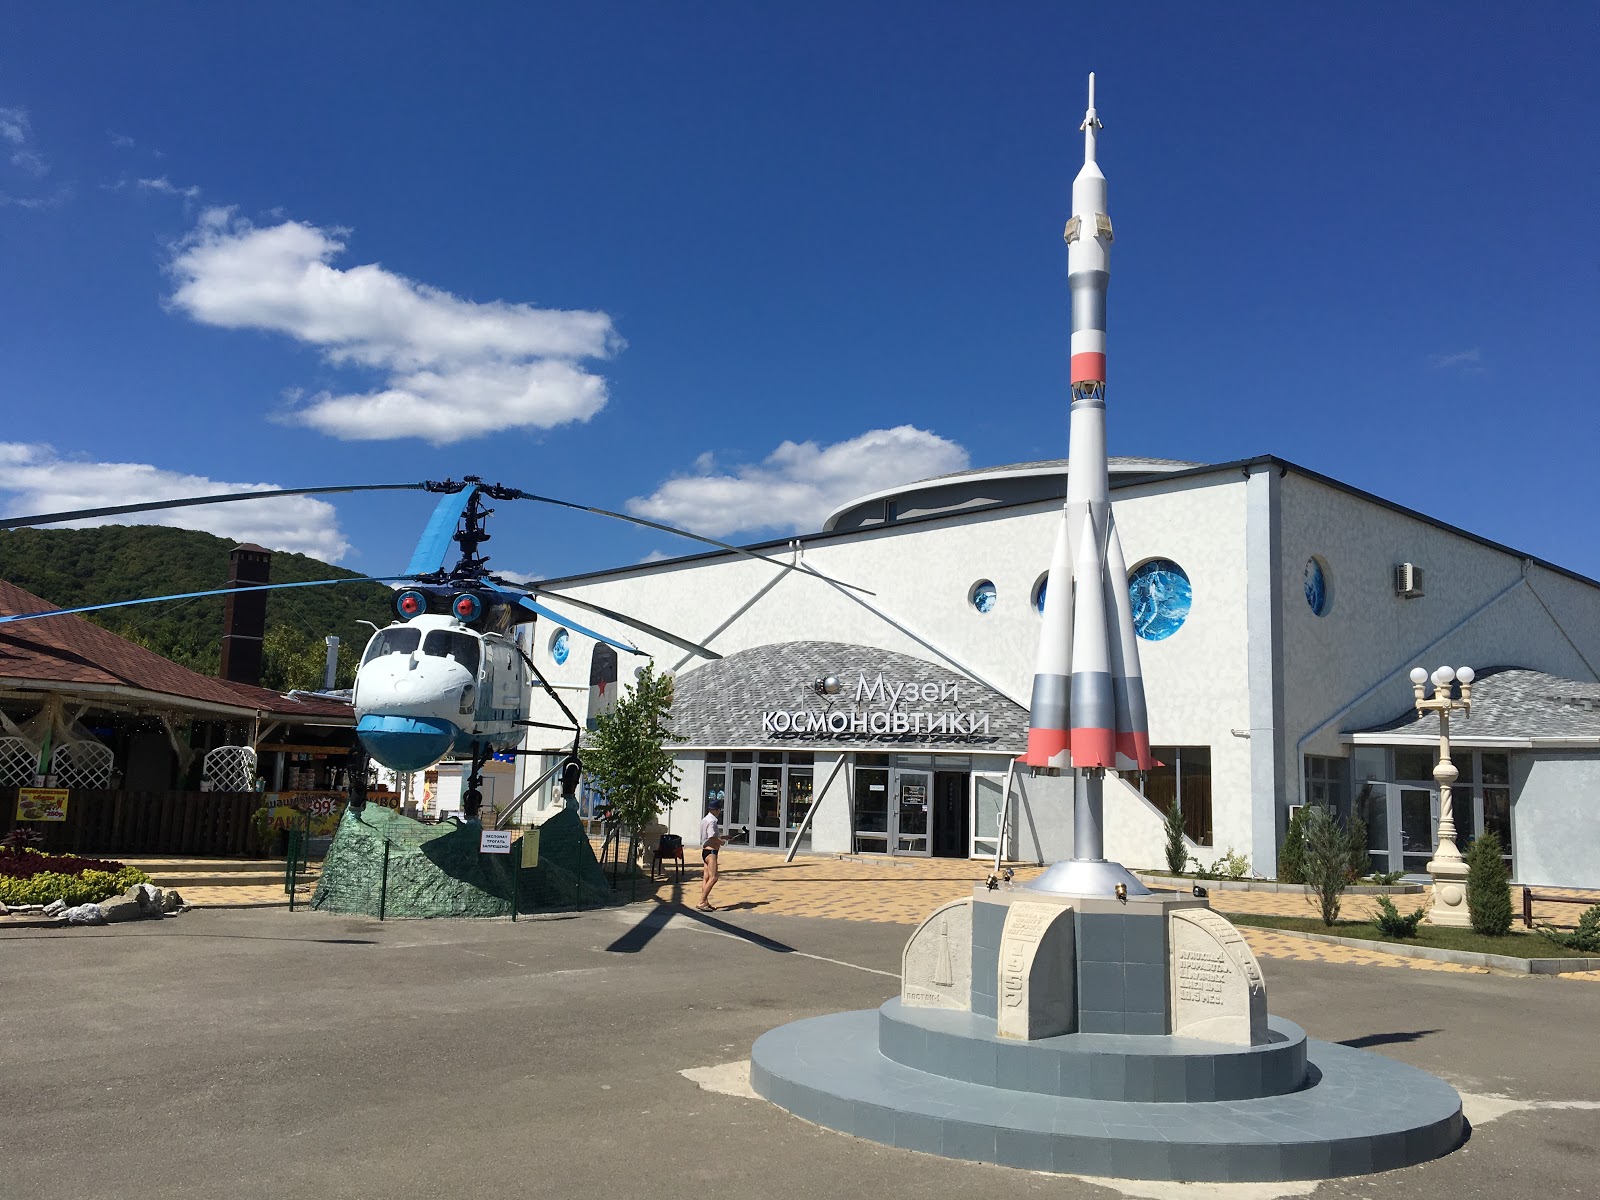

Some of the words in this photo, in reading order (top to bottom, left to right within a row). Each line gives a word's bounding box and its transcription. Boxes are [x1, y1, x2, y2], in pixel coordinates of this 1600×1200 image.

[855, 672, 958, 711] Музей
[761, 711, 990, 734] космонавтики
[313, 800, 331, 816] 99
[1006, 943, 1025, 1008] 1957
